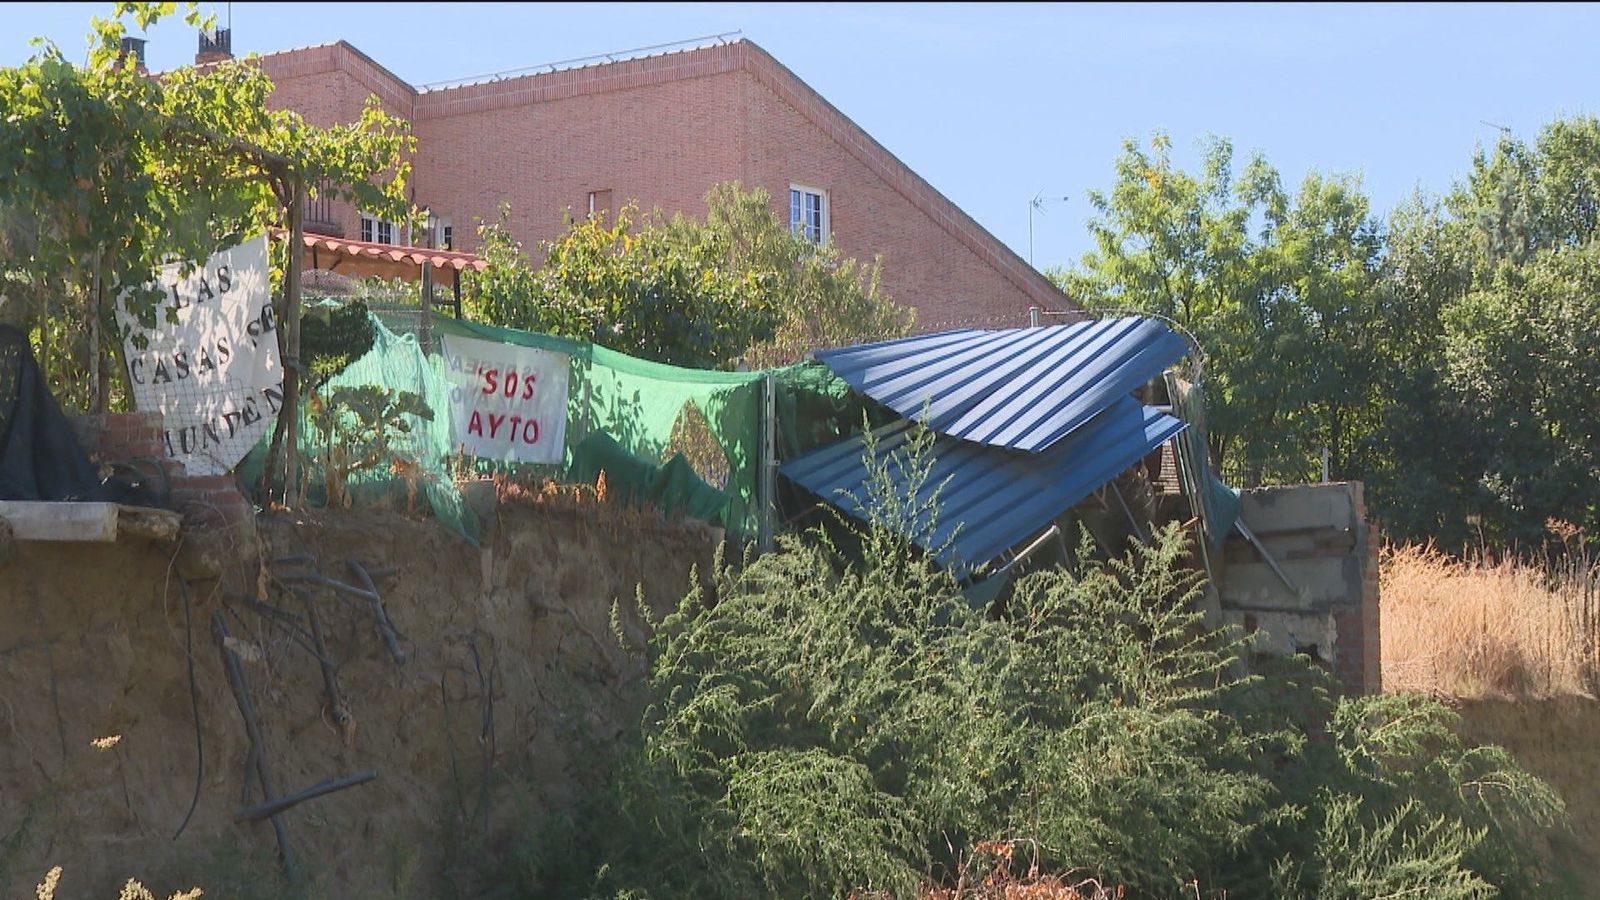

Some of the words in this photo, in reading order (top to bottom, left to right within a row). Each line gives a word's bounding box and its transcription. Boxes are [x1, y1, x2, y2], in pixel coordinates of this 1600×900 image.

[171, 265, 231, 309] LAS
[131, 337, 230, 385] CASAS
[247, 303, 276, 348] SE
[481, 368, 536, 400] SOS
[468, 409, 540, 444] AYTO
